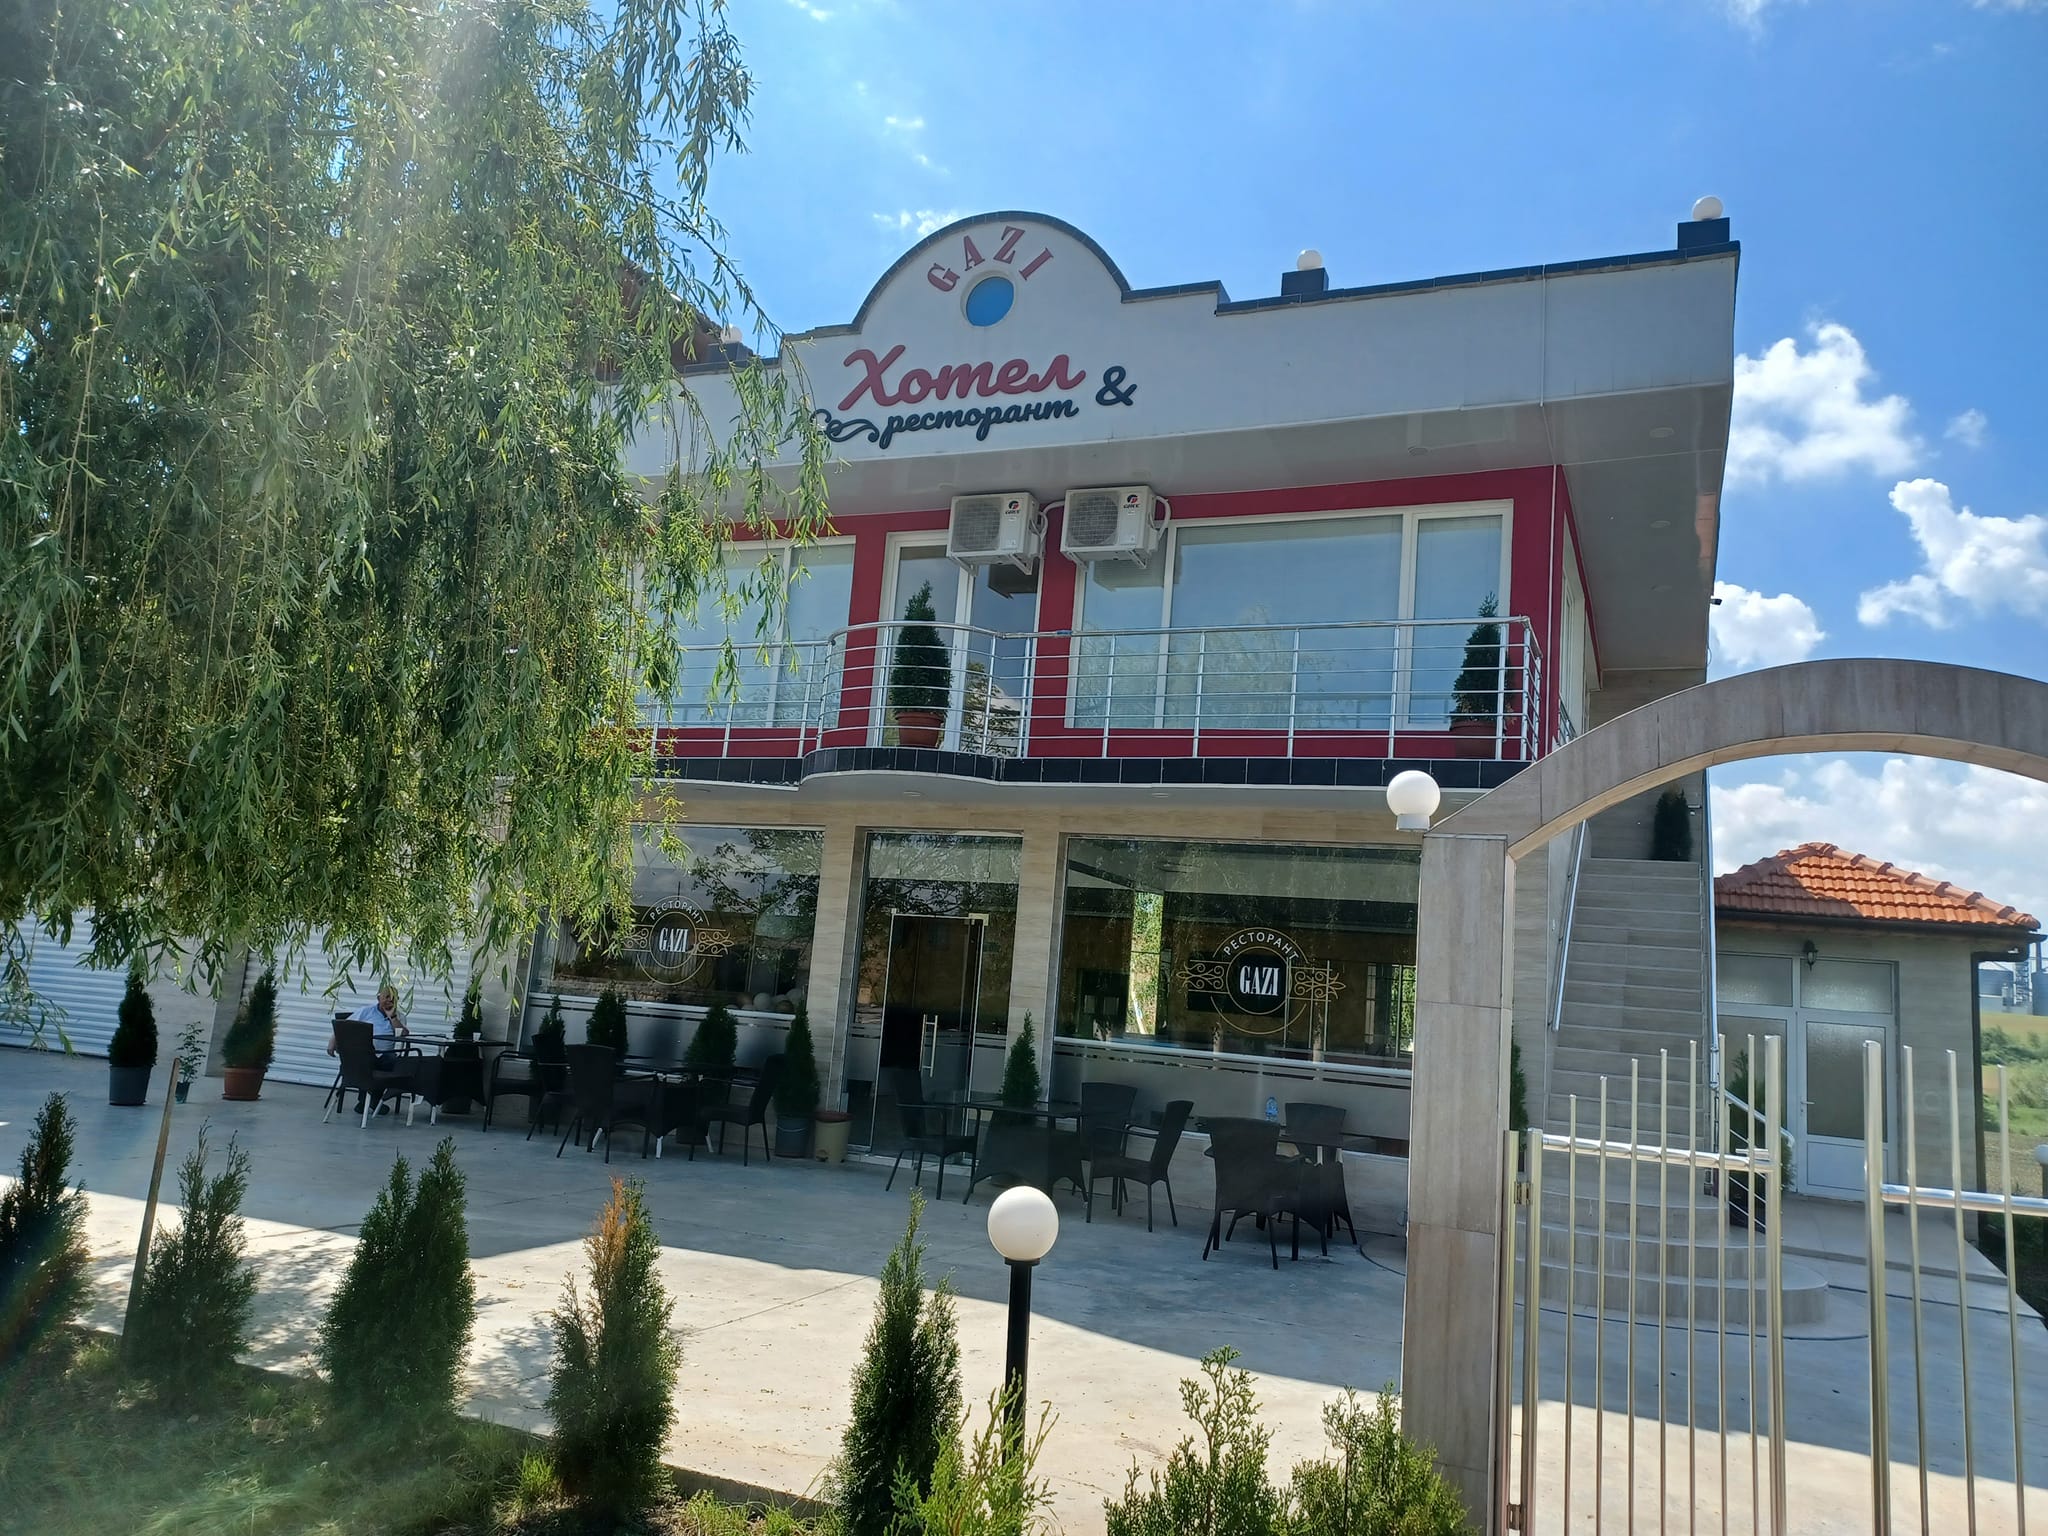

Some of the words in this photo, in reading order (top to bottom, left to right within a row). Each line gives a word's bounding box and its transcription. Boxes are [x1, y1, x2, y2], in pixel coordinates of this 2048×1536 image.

[926, 224, 1054, 292] GAZI
[837, 344, 1086, 412] Хотел
[1095, 365, 1138, 407] &
[878, 399, 1080, 450] ресторант
[650, 900, 704, 925] РЕСТОРАНТ
[658, 927, 689, 953] GAZI
[1223, 931, 1300, 961] РЕСТОРАНТ
[1239, 965, 1280, 997] GAZI
